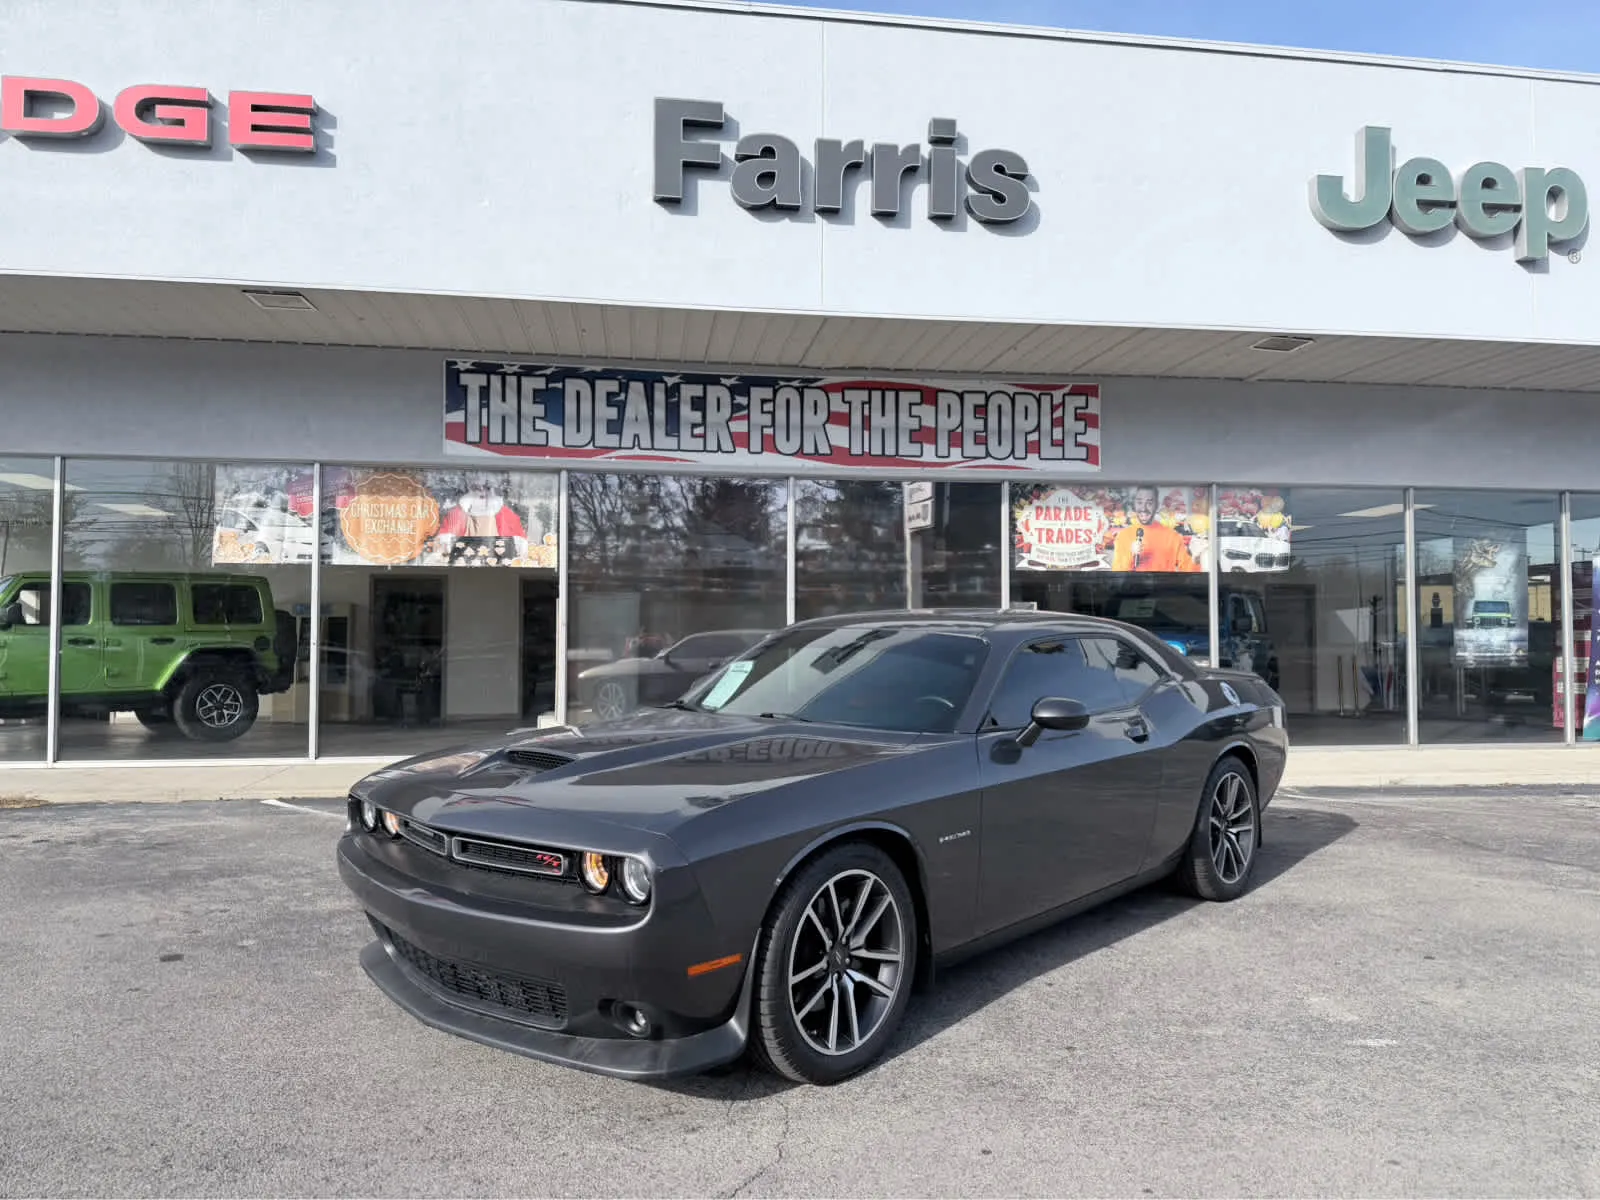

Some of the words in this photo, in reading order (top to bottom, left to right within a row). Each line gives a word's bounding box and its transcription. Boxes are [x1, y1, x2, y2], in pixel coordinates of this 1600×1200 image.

[0, 75, 318, 153] DGE
[654, 96, 1031, 225] Farris
[1308, 126, 1588, 262] Jeep
[458, 372, 550, 447] THE
[562, 376, 736, 454] DEALER
[748, 383, 833, 456] FOR
[842, 386, 924, 458] THE
[935, 390, 1089, 461] PEOPLE
[351, 503, 408, 518] CHRISTMAS
[1034, 528, 1094, 544] TRADES
[1035, 505, 1093, 521] PARADE
